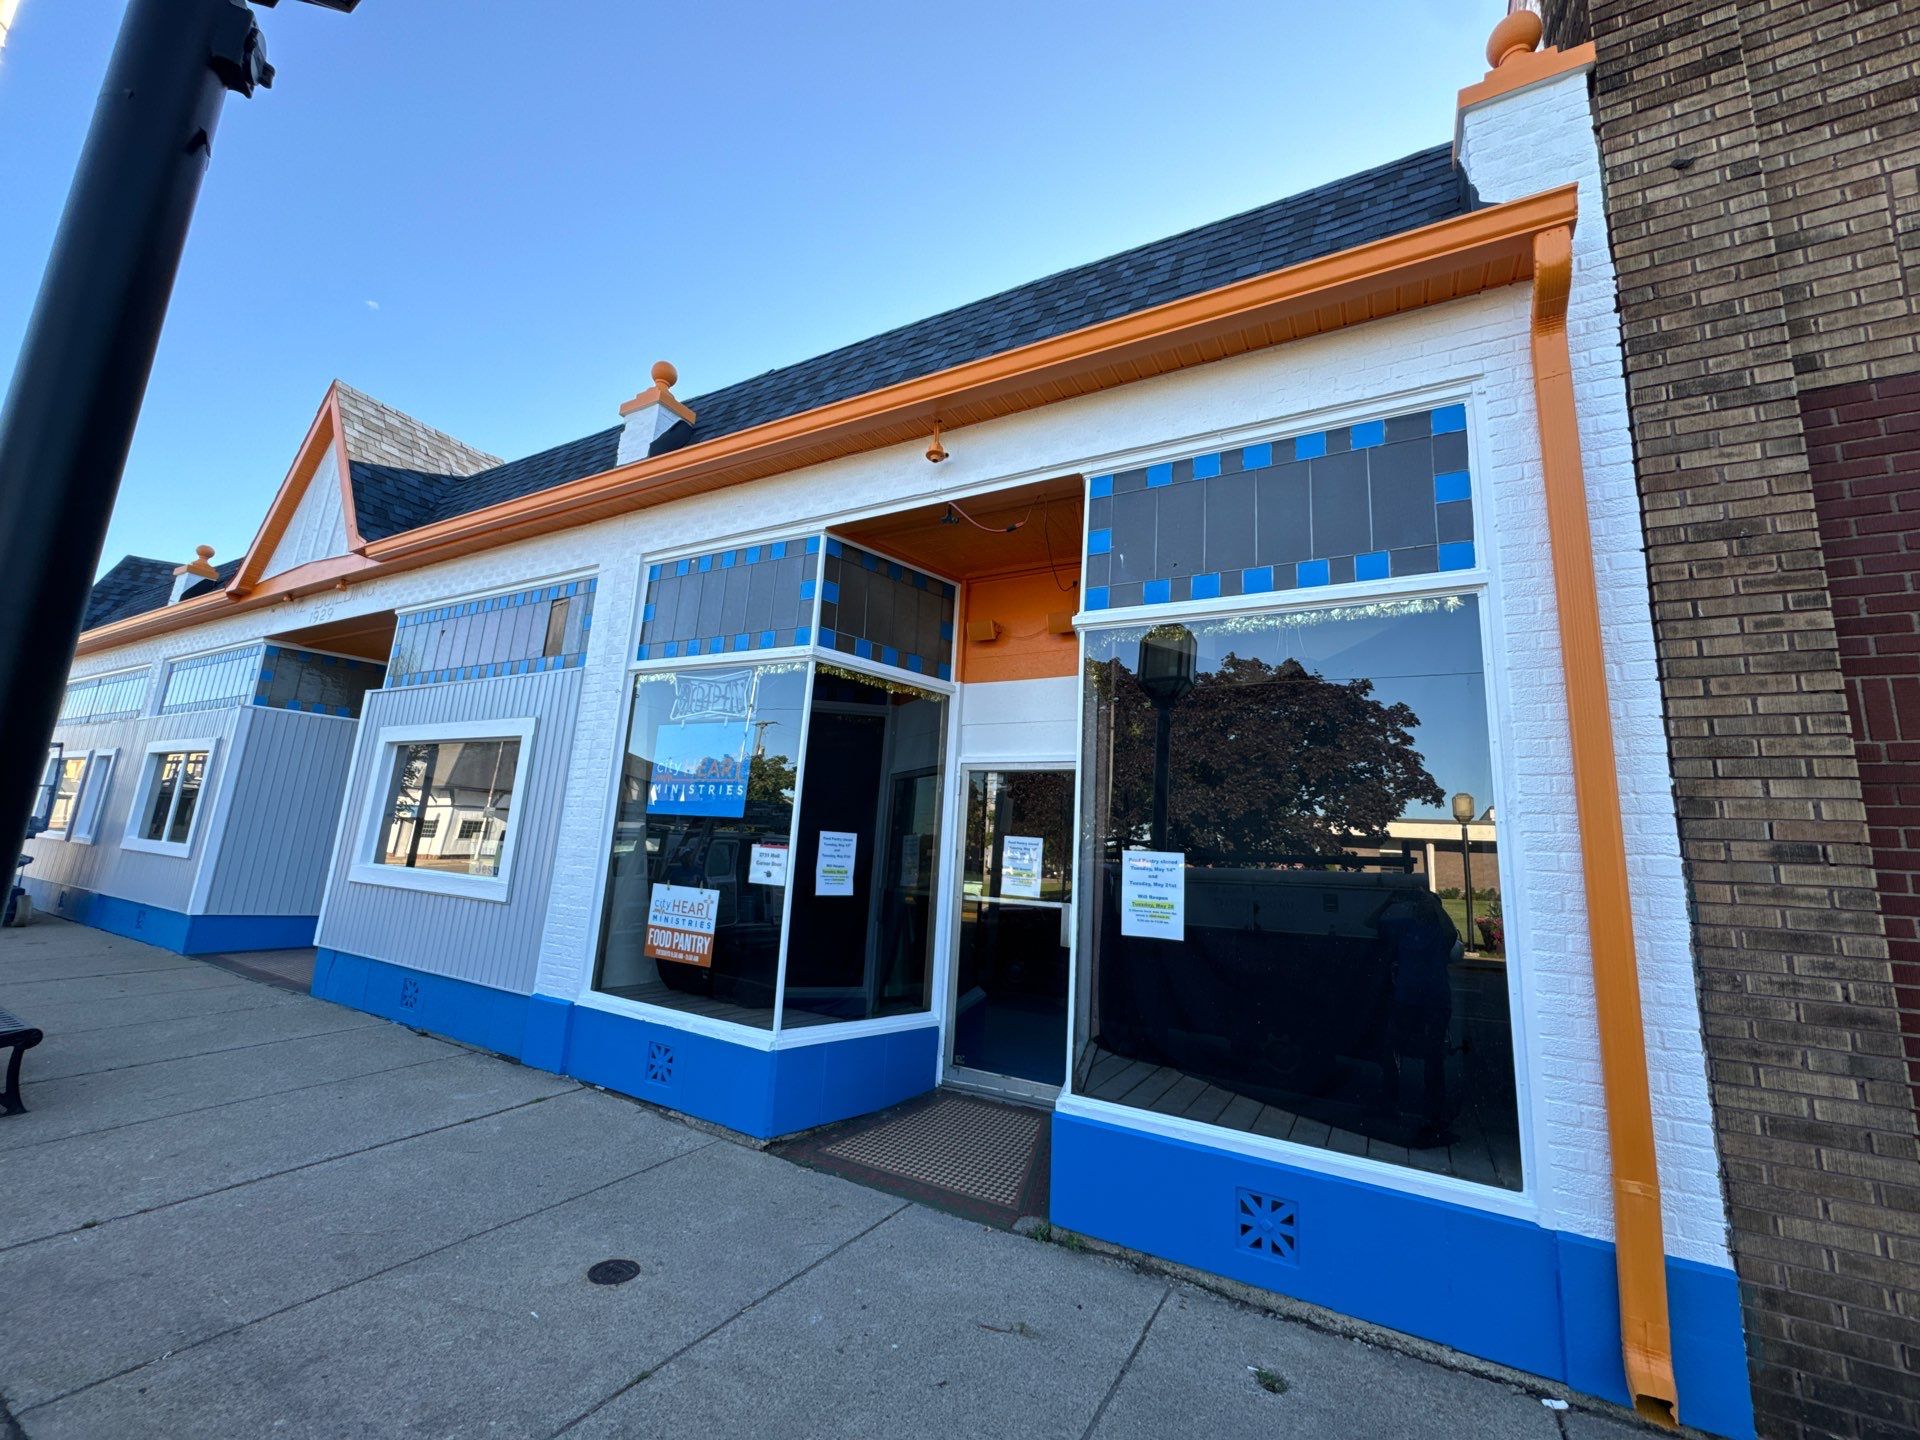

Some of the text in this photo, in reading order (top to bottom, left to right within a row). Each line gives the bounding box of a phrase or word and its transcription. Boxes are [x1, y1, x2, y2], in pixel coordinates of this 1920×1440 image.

[309, 607, 334, 624] 1929
[656, 757, 682, 775] city
[653, 783, 744, 796] MINISTRIES
[654, 899, 671, 911] city
[652, 914, 712, 930] MINISTRIES
[647, 927, 711, 955] FOOD PANTRY
